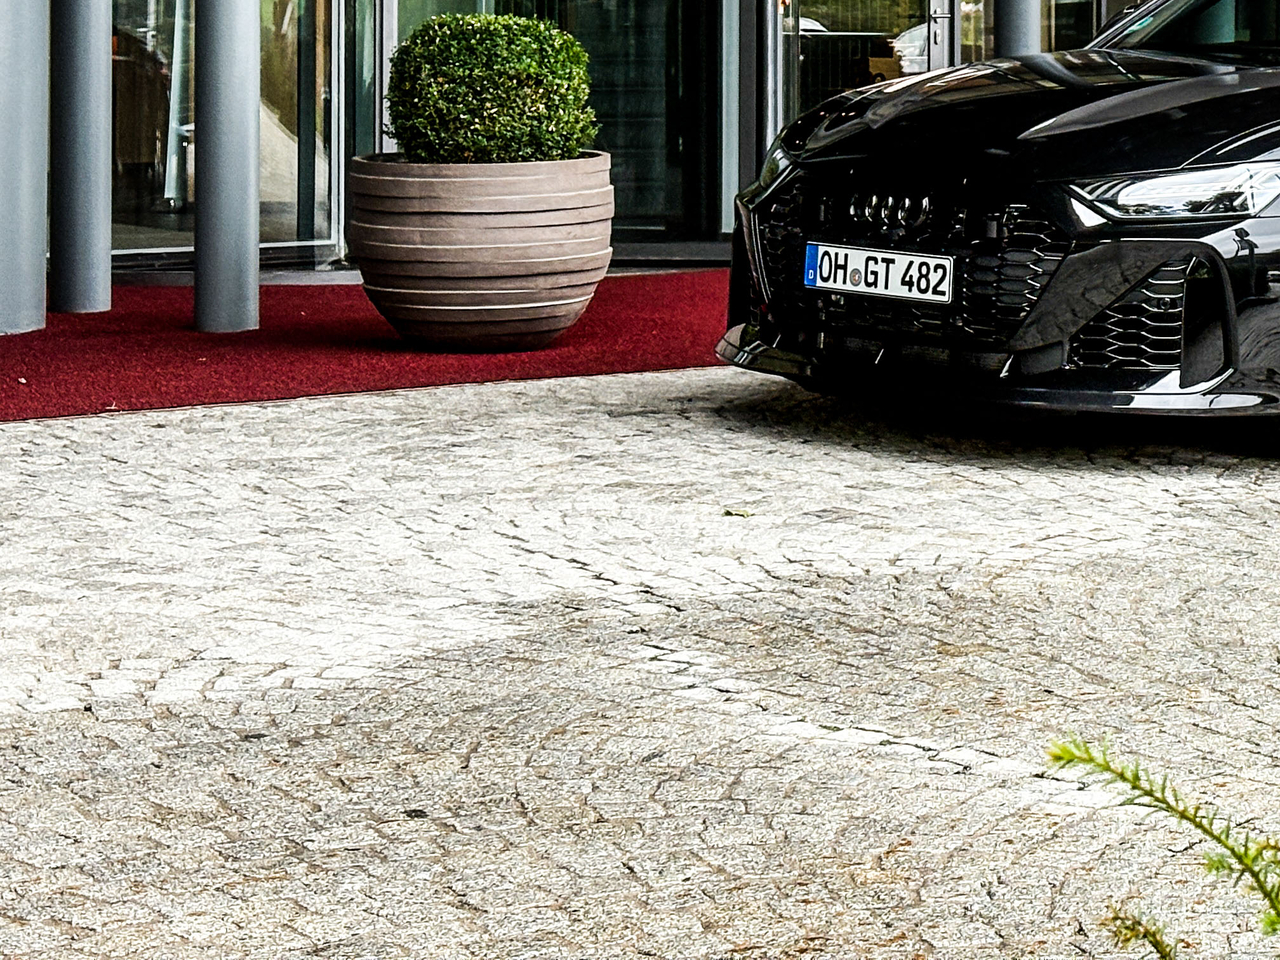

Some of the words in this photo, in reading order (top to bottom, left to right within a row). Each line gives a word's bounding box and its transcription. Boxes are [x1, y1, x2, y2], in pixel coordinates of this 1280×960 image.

[808, 269, 814, 279] D
[818, 250, 849, 285] OH
[864, 255, 896, 290] GT
[900, 260, 948, 297] 482
